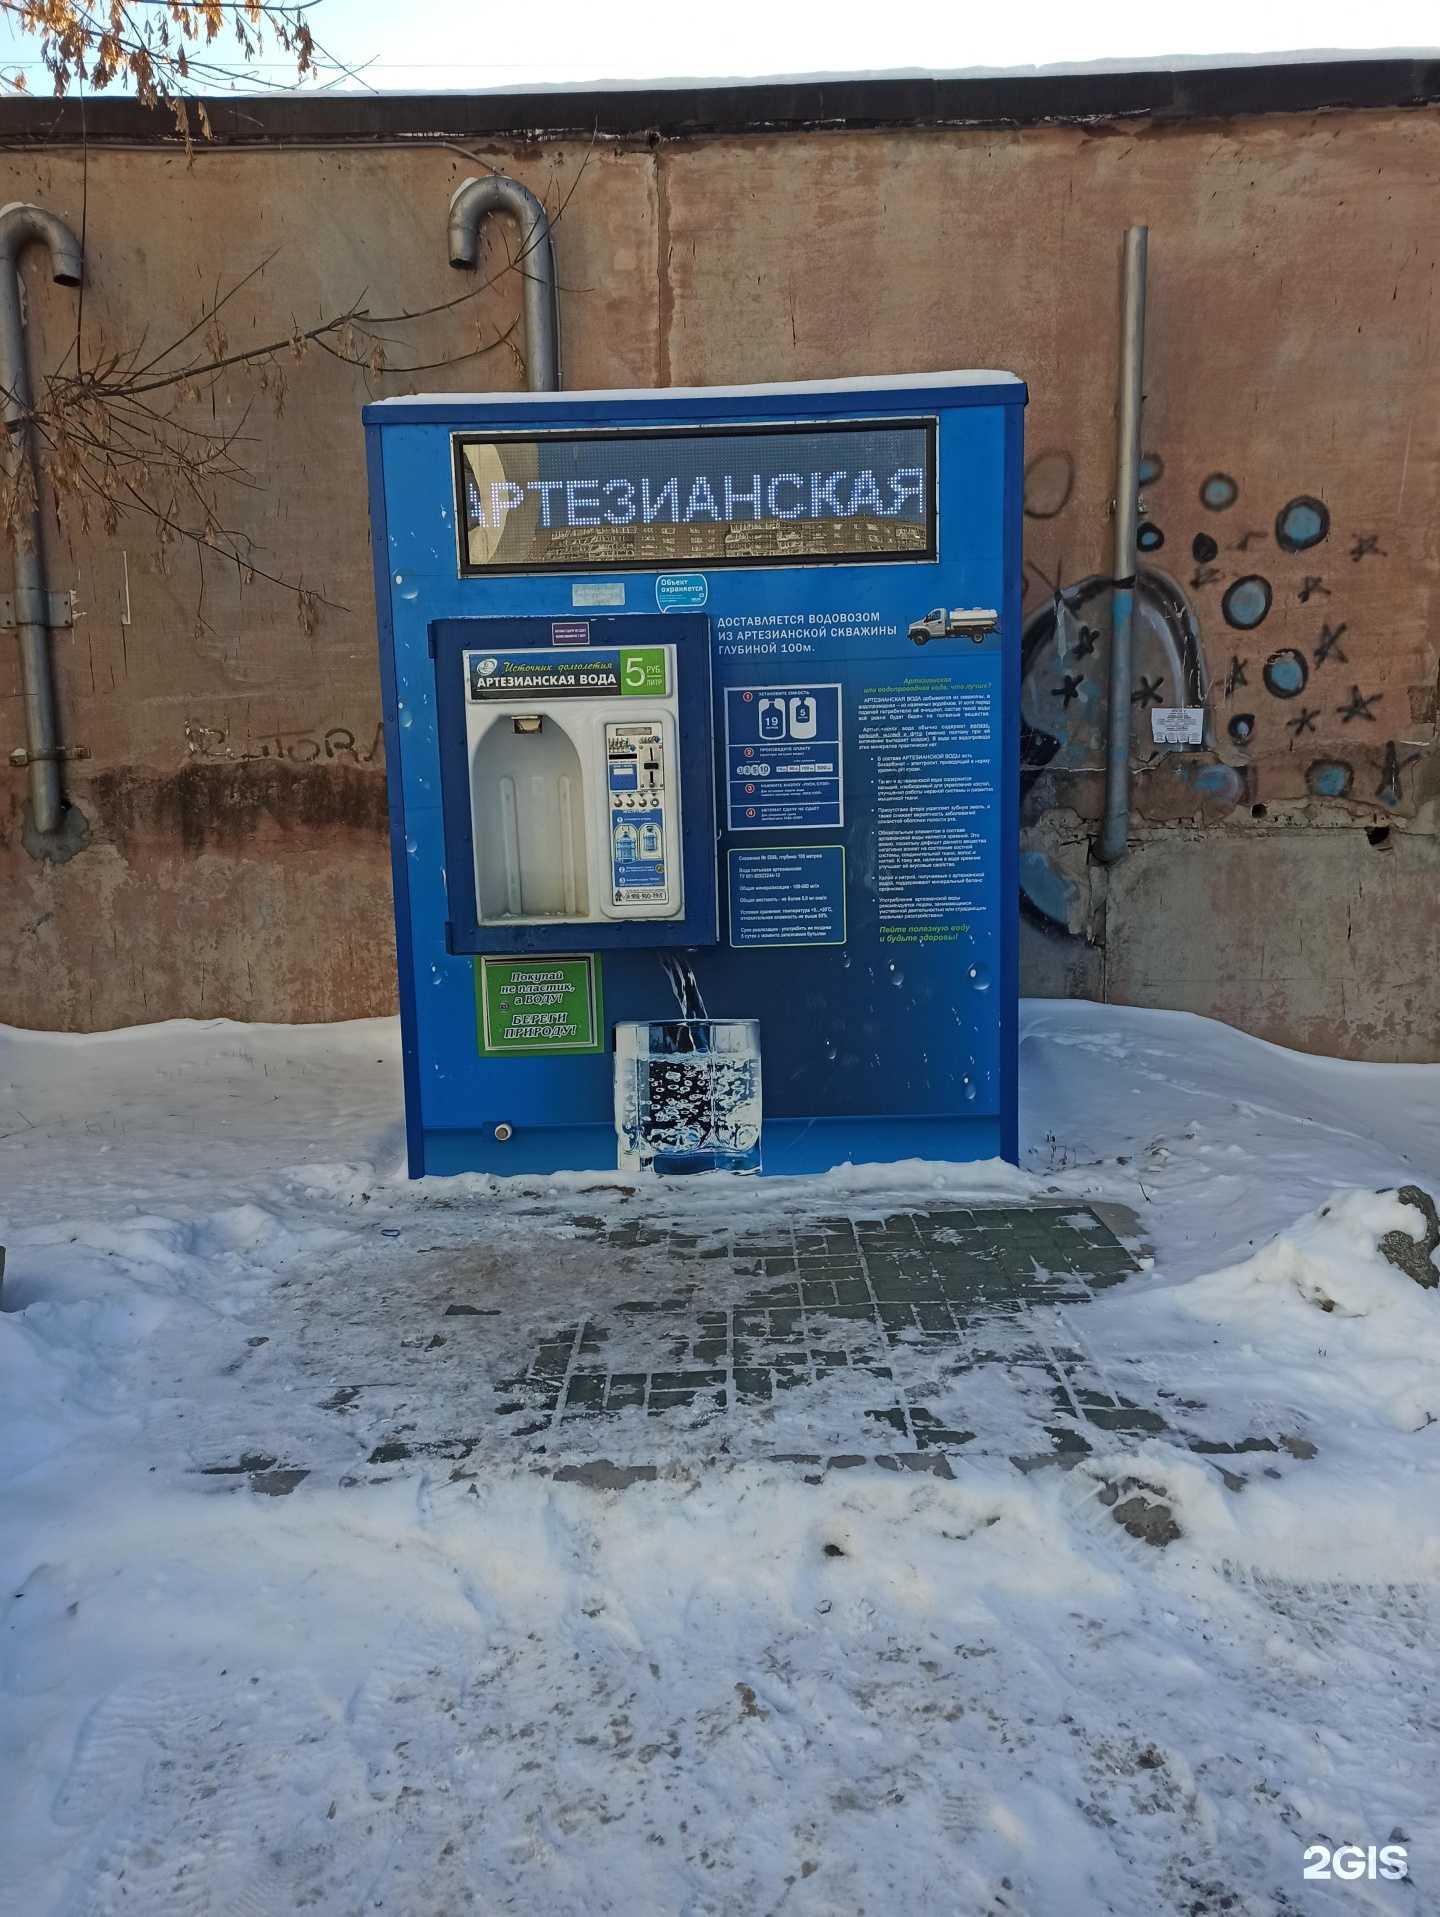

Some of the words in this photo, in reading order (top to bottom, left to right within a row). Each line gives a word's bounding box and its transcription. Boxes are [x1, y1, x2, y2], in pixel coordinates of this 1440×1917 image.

[661, 578, 688, 586] Объект
[661, 585, 703, 593] охраняется
[717, 614, 804, 628] ДОСТАВЛЯЕТСЯ
[808, 612, 880, 624] ВОДОВОЗОМ
[718, 631, 733, 641] ИЗ
[737, 626, 827, 640] АРТЕЗИАНСКОЙ
[830, 625, 897, 637] СКВАЖИНЫ
[718, 641, 777, 655] ГЛУБИНОЙ
[503, 661, 553, 673] Источник
[557, 661, 613, 673] долголетия
[626, 657, 646, 687] 5
[646, 665, 662, 674] РУБ.
[477, 675, 575, 688] АРТЕЗИАНСКАЯ
[580, 673, 617, 686] ВОДА
[646, 679, 663, 687] ЛИТР
[765, 717, 778, 726] 19
[511, 971, 563, 983] Покупай
[500, 986, 515, 994] не
[518, 983, 575, 993] пластик,
[514, 997, 522, 1005] а
[525, 994, 563, 1005] ВОДУ!
[512, 1013, 568, 1025] БЕРЕГИ
[504, 1025, 576, 1039] ПРИРОДУ!
